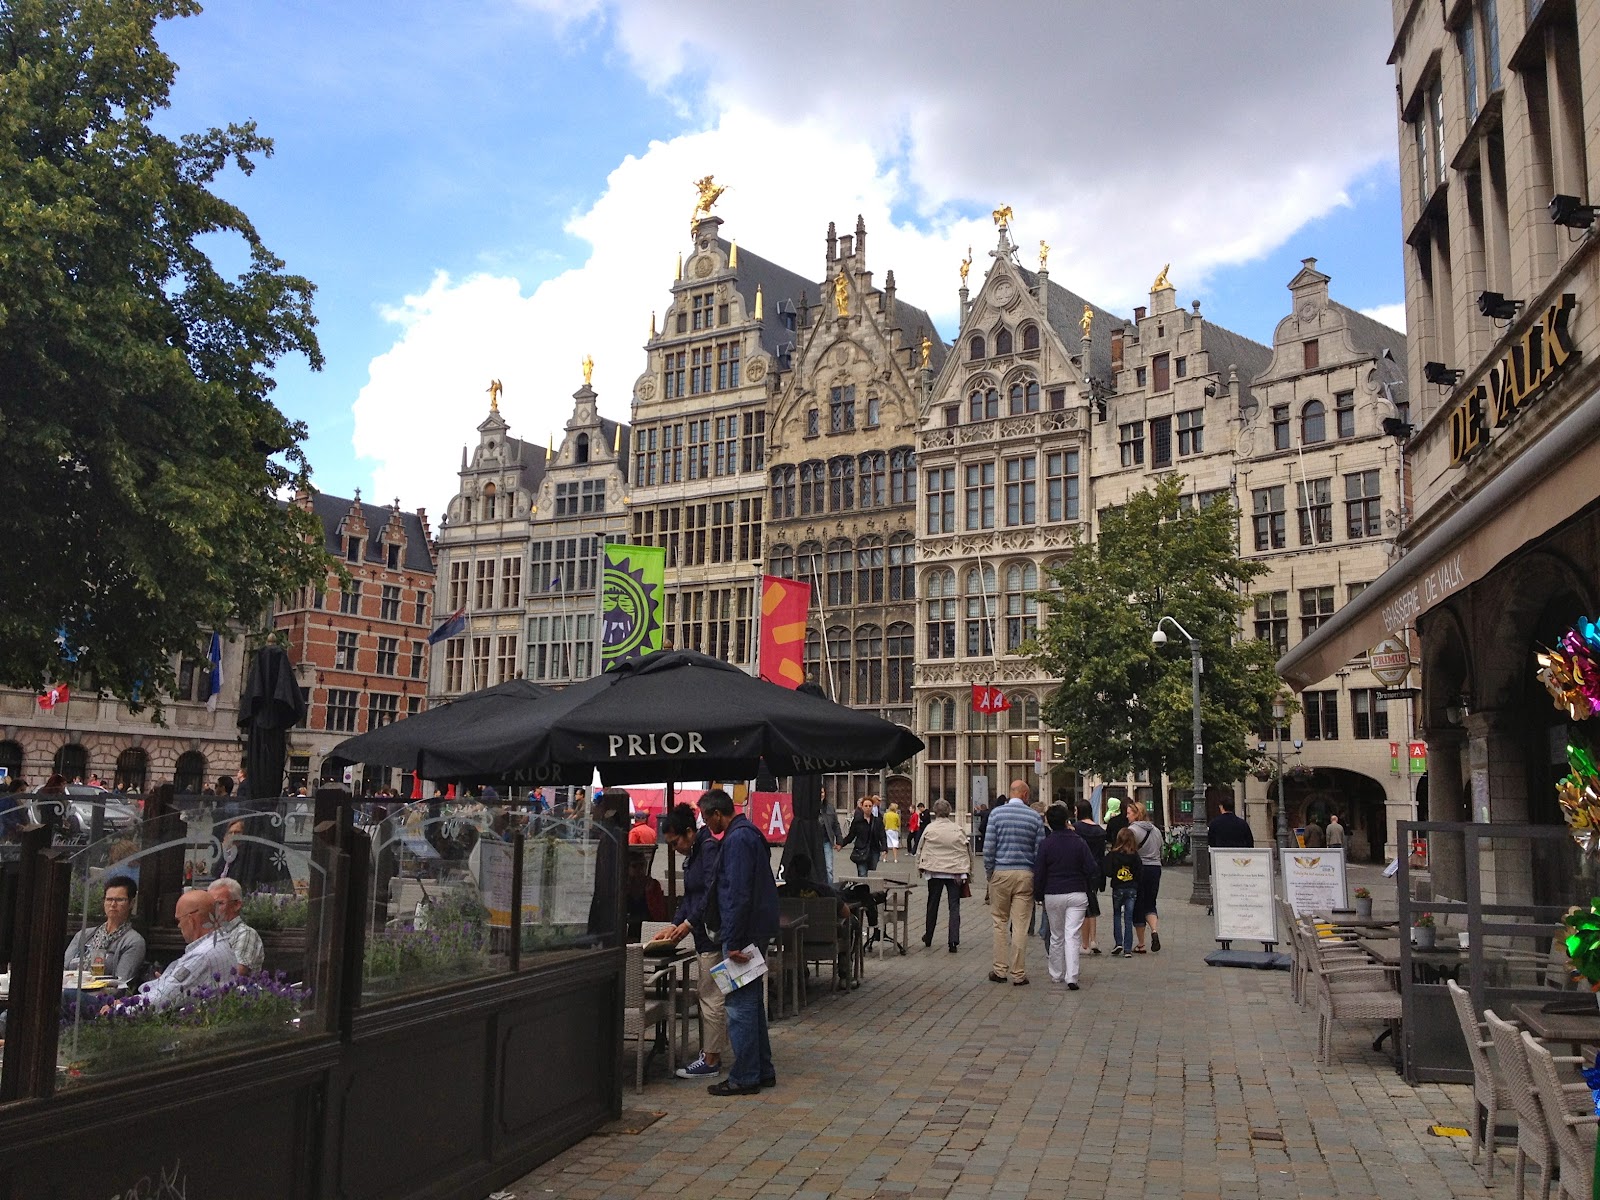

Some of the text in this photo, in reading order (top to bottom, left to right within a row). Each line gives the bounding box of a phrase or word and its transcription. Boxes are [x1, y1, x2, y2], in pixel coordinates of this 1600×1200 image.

[1449, 294, 1574, 467] DE VALK
[1381, 554, 1464, 632] BRASSERIE DE VALK
[1372, 653, 1407, 666] PRIMUS
[608, 732, 708, 757] PRIOR
[1413, 746, 1422, 755] A
[768, 801, 786, 835] A
